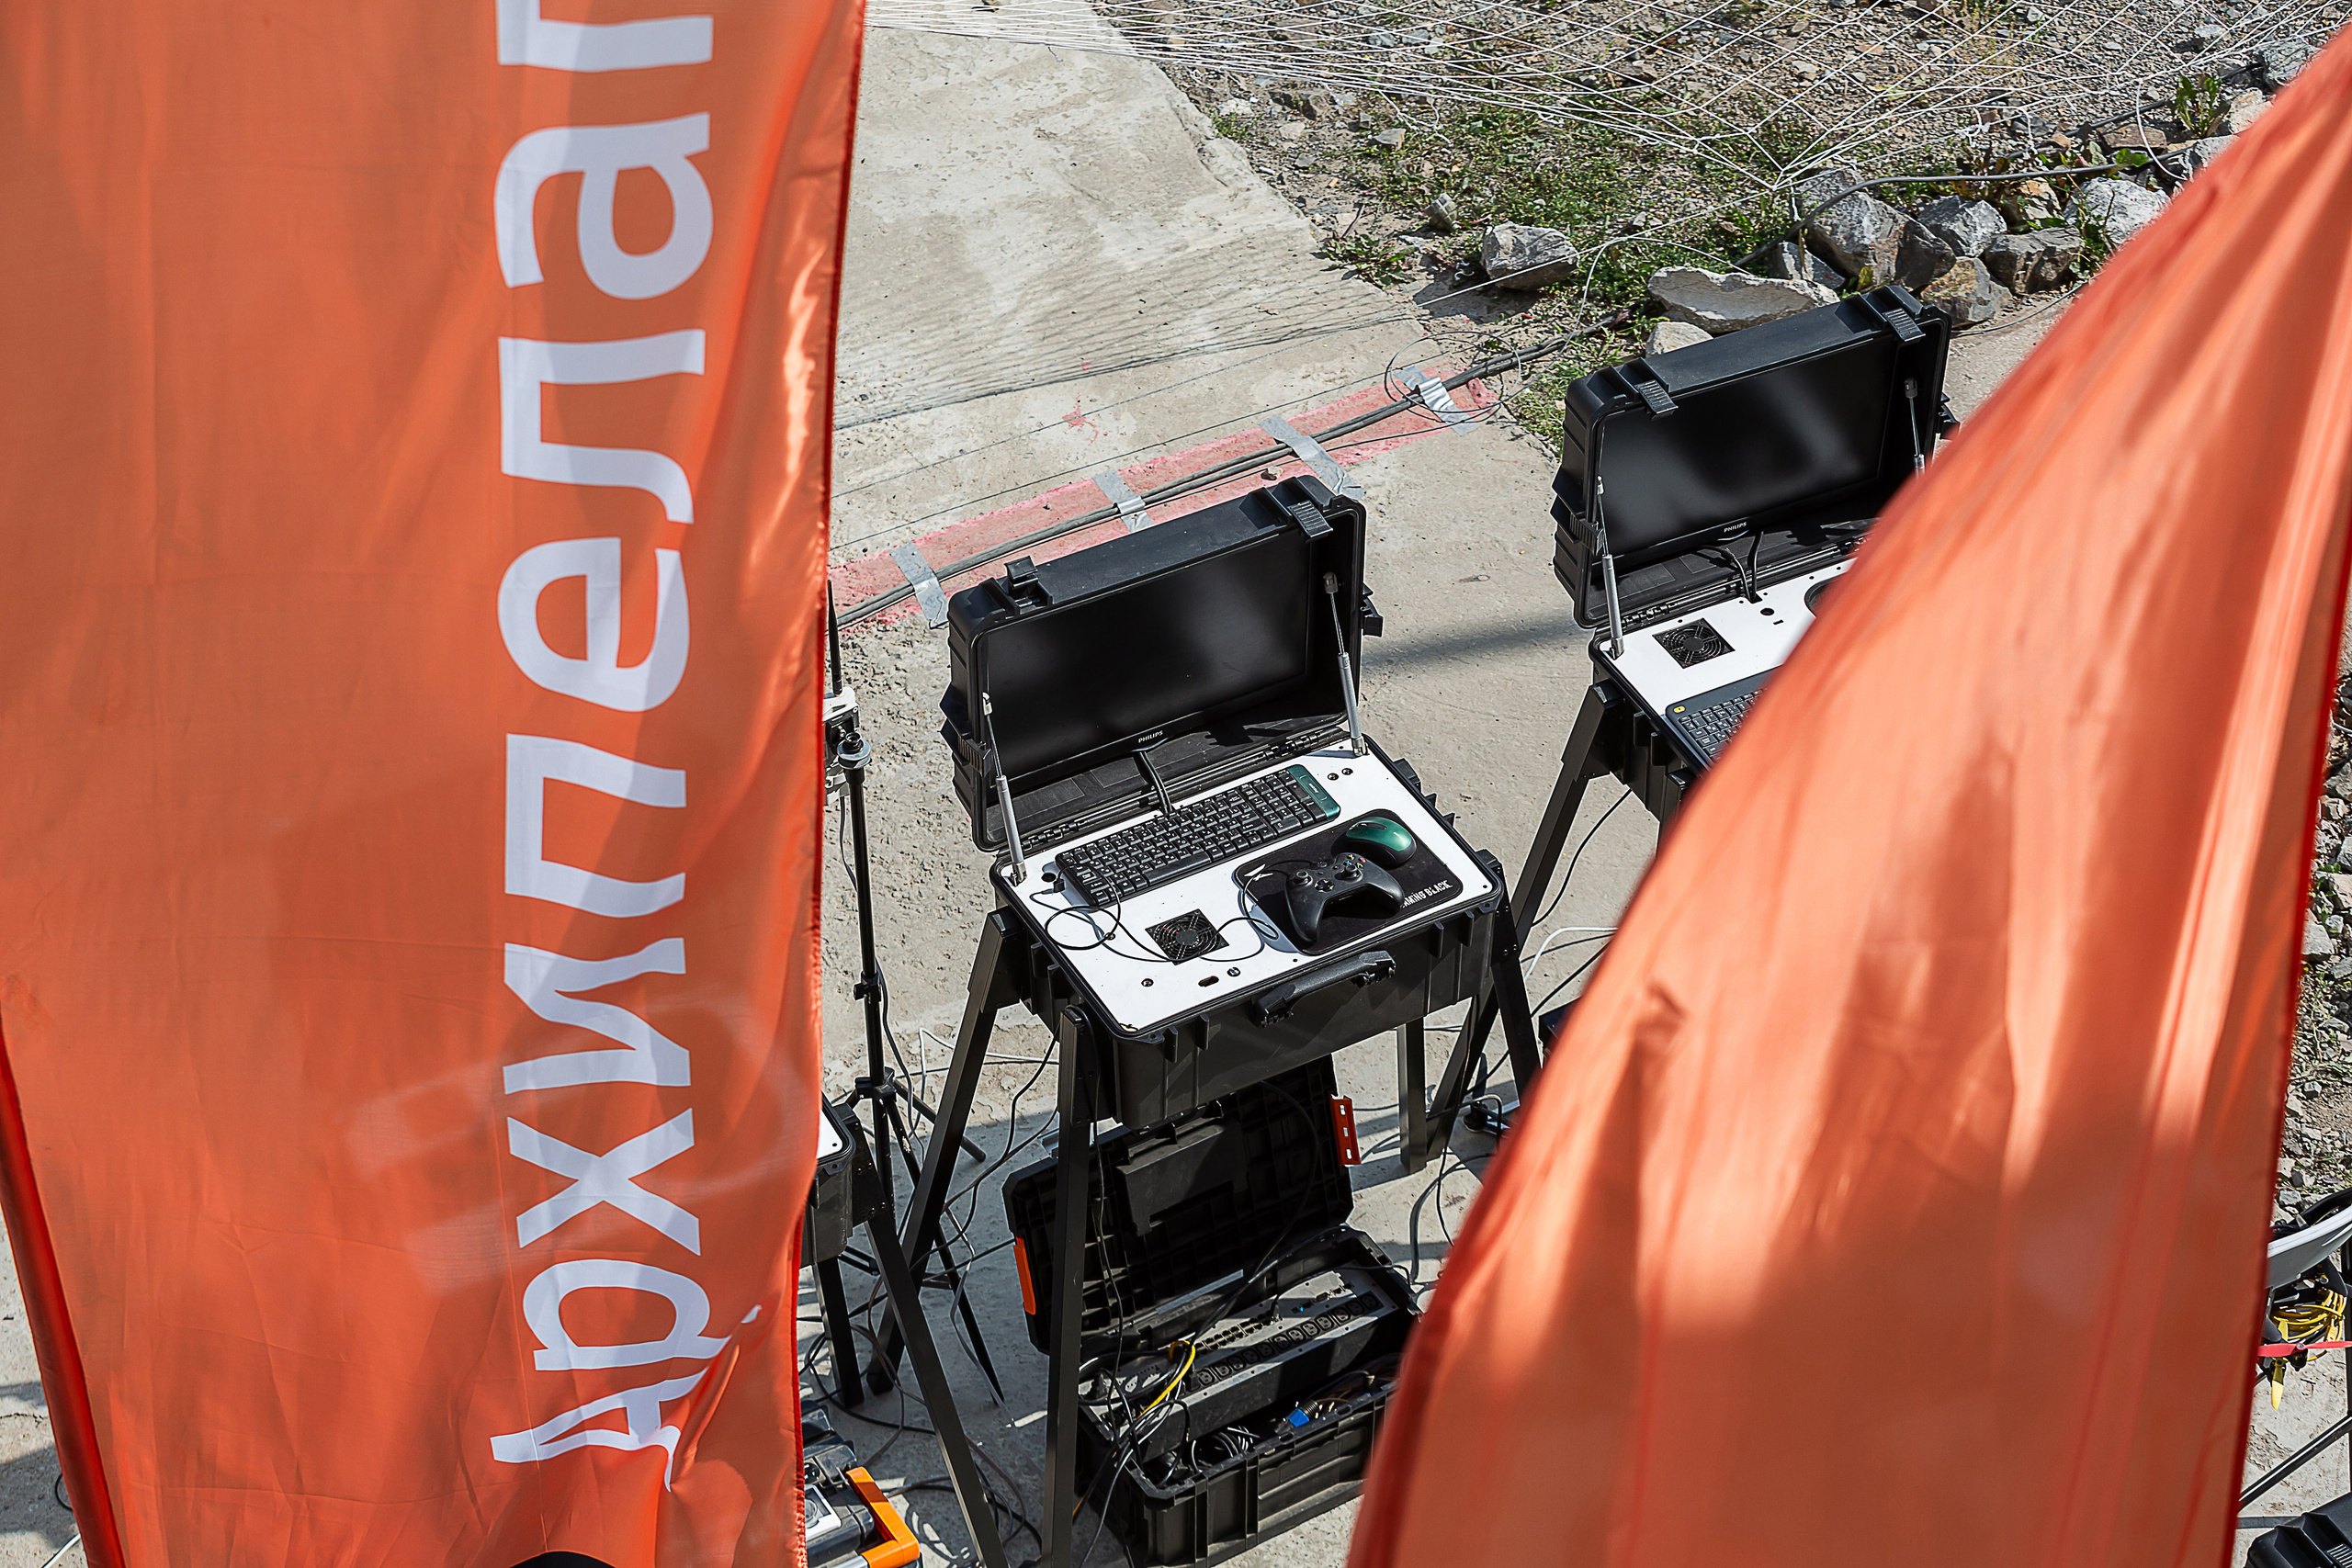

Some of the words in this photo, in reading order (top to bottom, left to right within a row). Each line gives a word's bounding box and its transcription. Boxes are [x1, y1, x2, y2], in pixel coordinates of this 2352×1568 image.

[1724, 521, 1747, 533] PHILIPS
[1138, 730, 1163, 743] PHILIPS
[1424, 880, 1453, 897] BLACK
